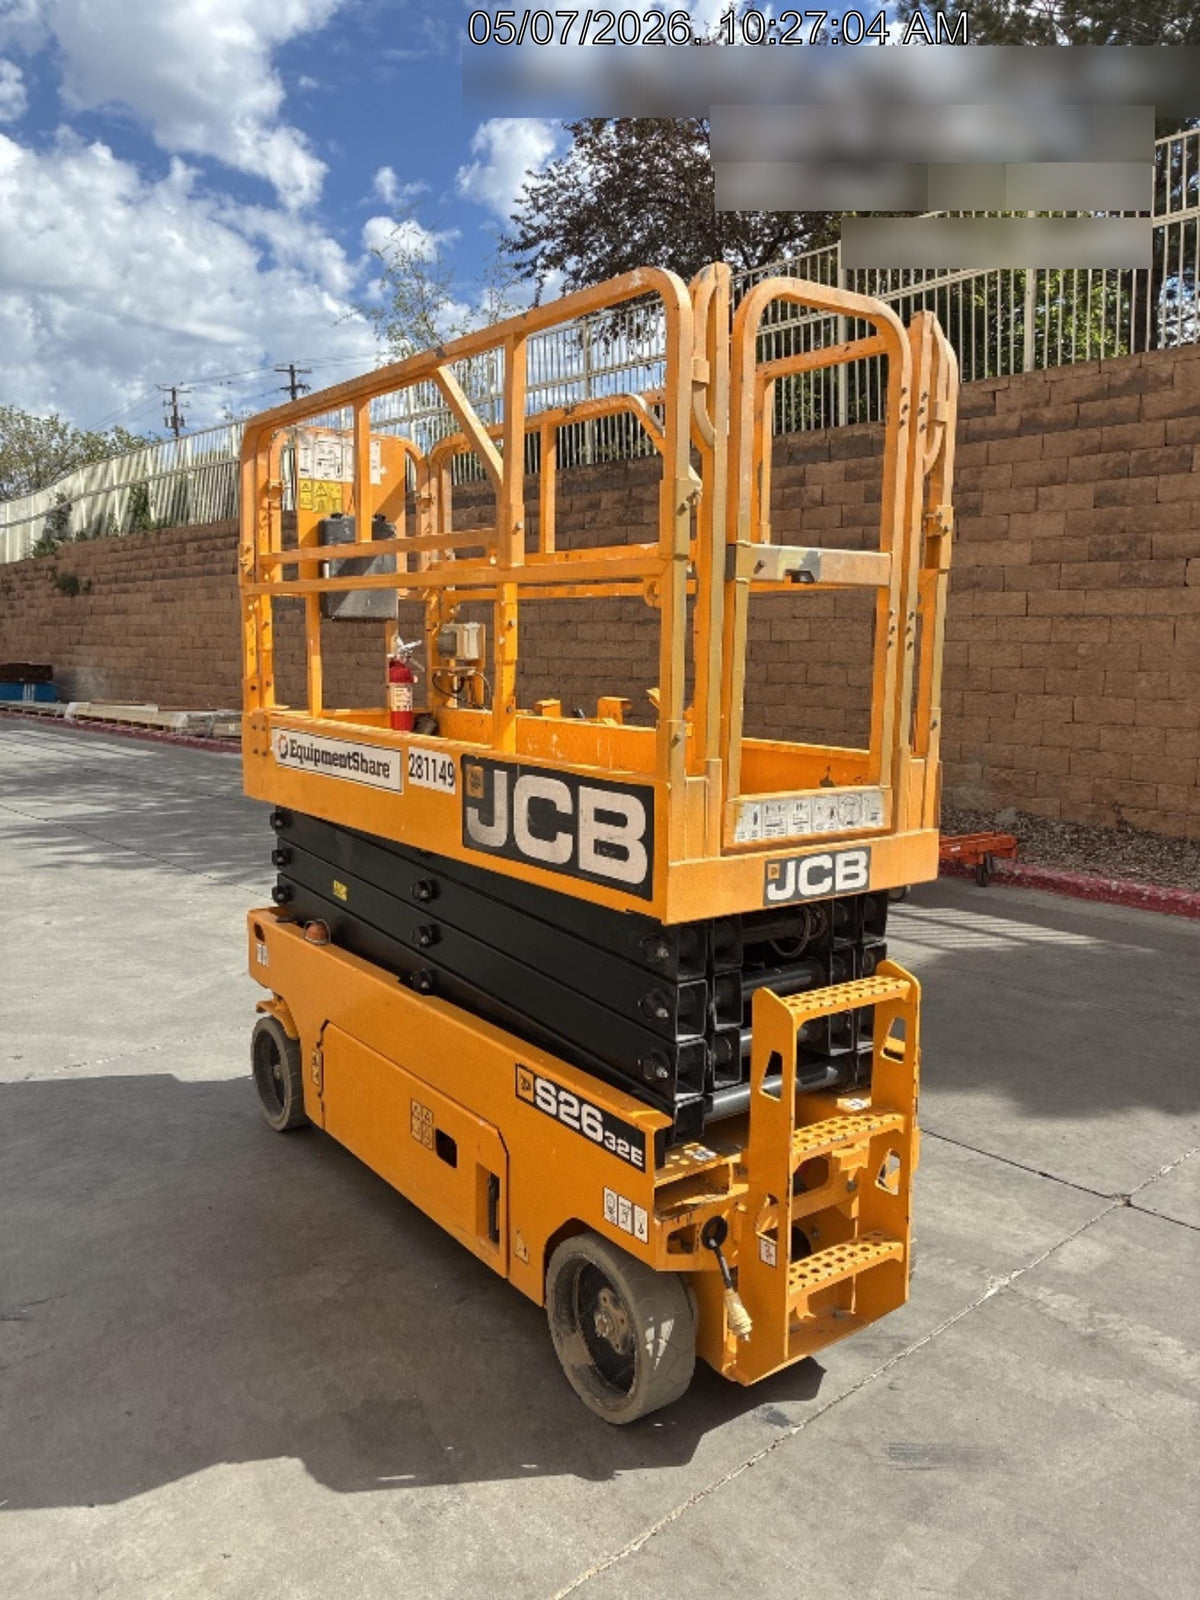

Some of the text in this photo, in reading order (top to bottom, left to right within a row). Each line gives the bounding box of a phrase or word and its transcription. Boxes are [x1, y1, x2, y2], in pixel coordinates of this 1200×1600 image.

[289, 738, 391, 780] EquipmentShare
[408, 753, 455, 788] 281149
[466, 769, 648, 885] JCB
[766, 850, 869, 901] JCB
